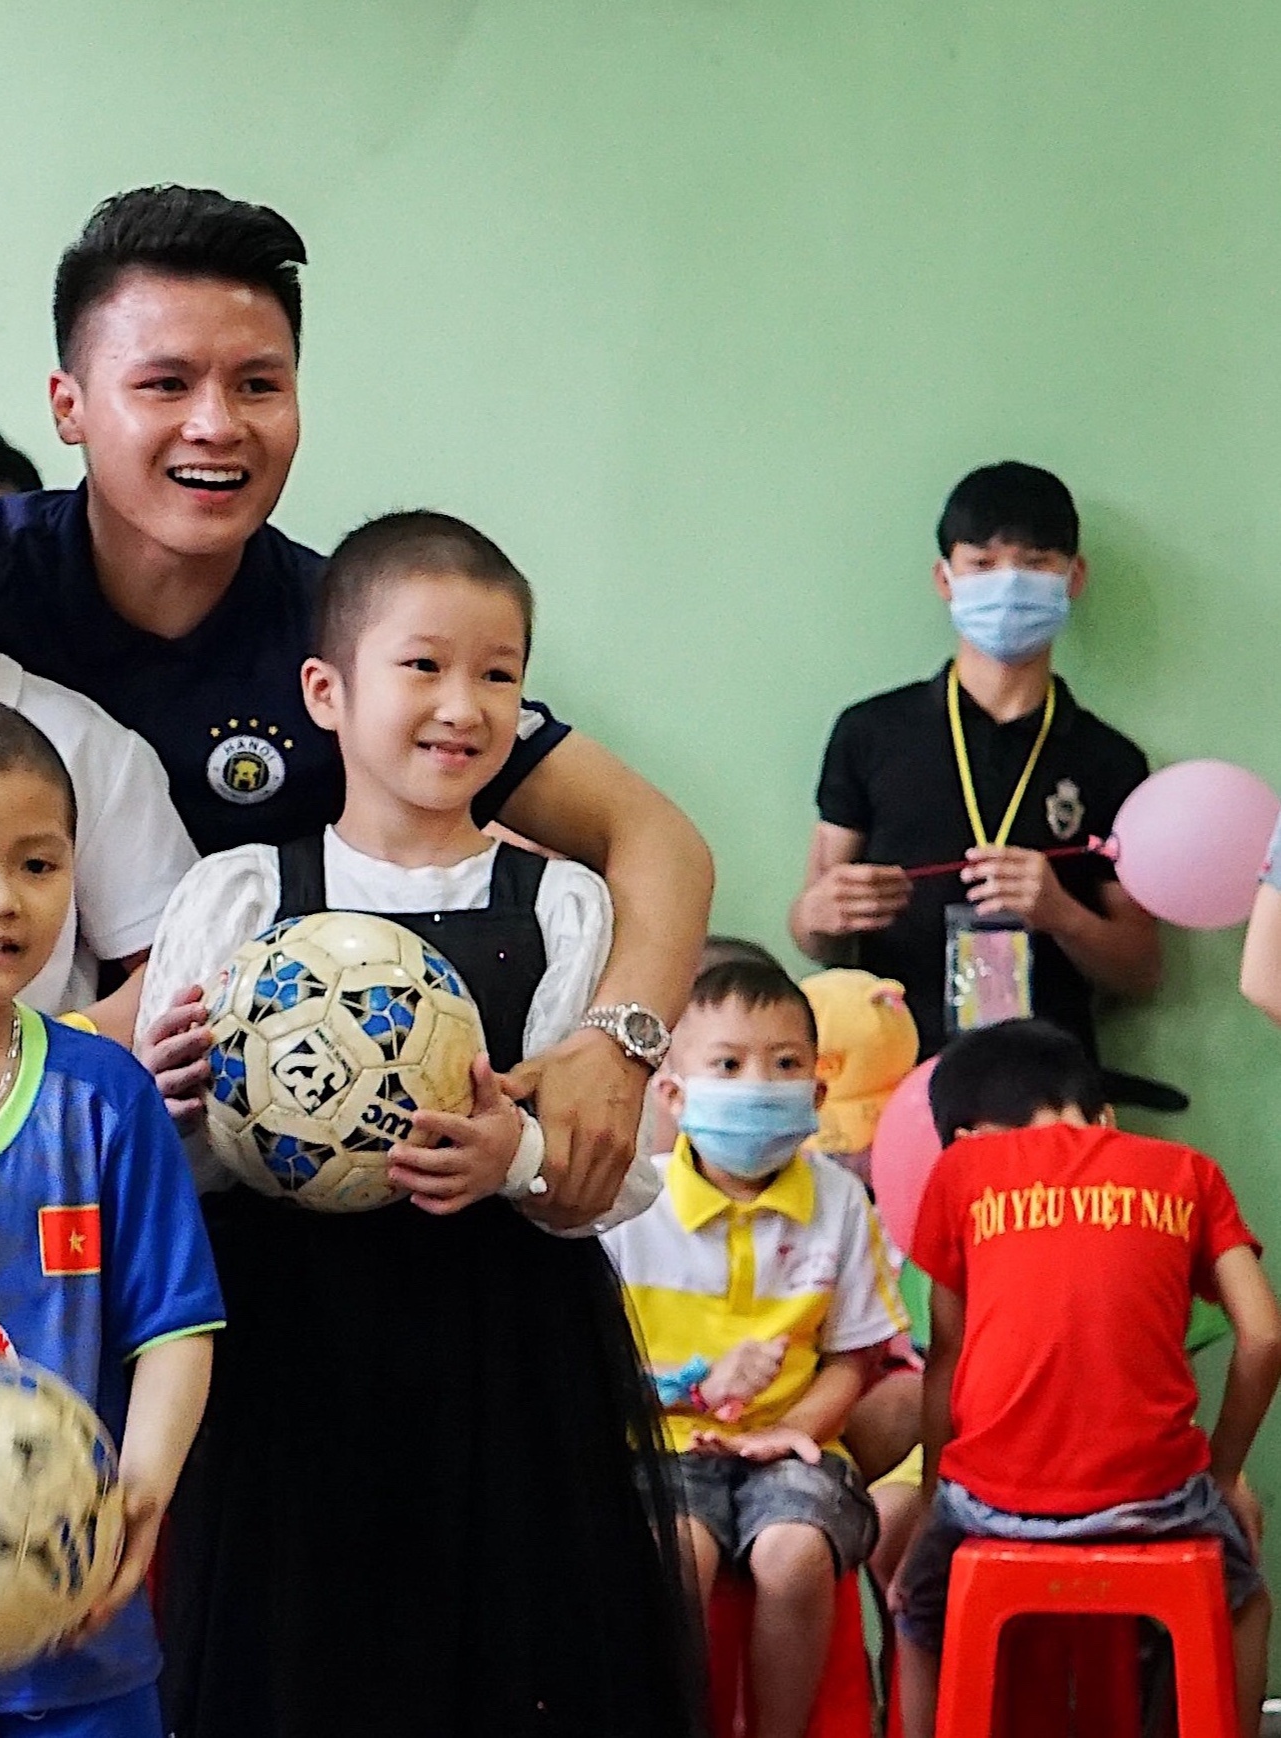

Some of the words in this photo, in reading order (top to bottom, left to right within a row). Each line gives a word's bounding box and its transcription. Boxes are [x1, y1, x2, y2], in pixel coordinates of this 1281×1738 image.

[970, 1185, 1006, 1246] TÔI
[1011, 1180, 1066, 1231] YÊU
[1071, 1180, 1136, 1231] VIỆT
[1141, 1188, 1194, 1242] NAM
